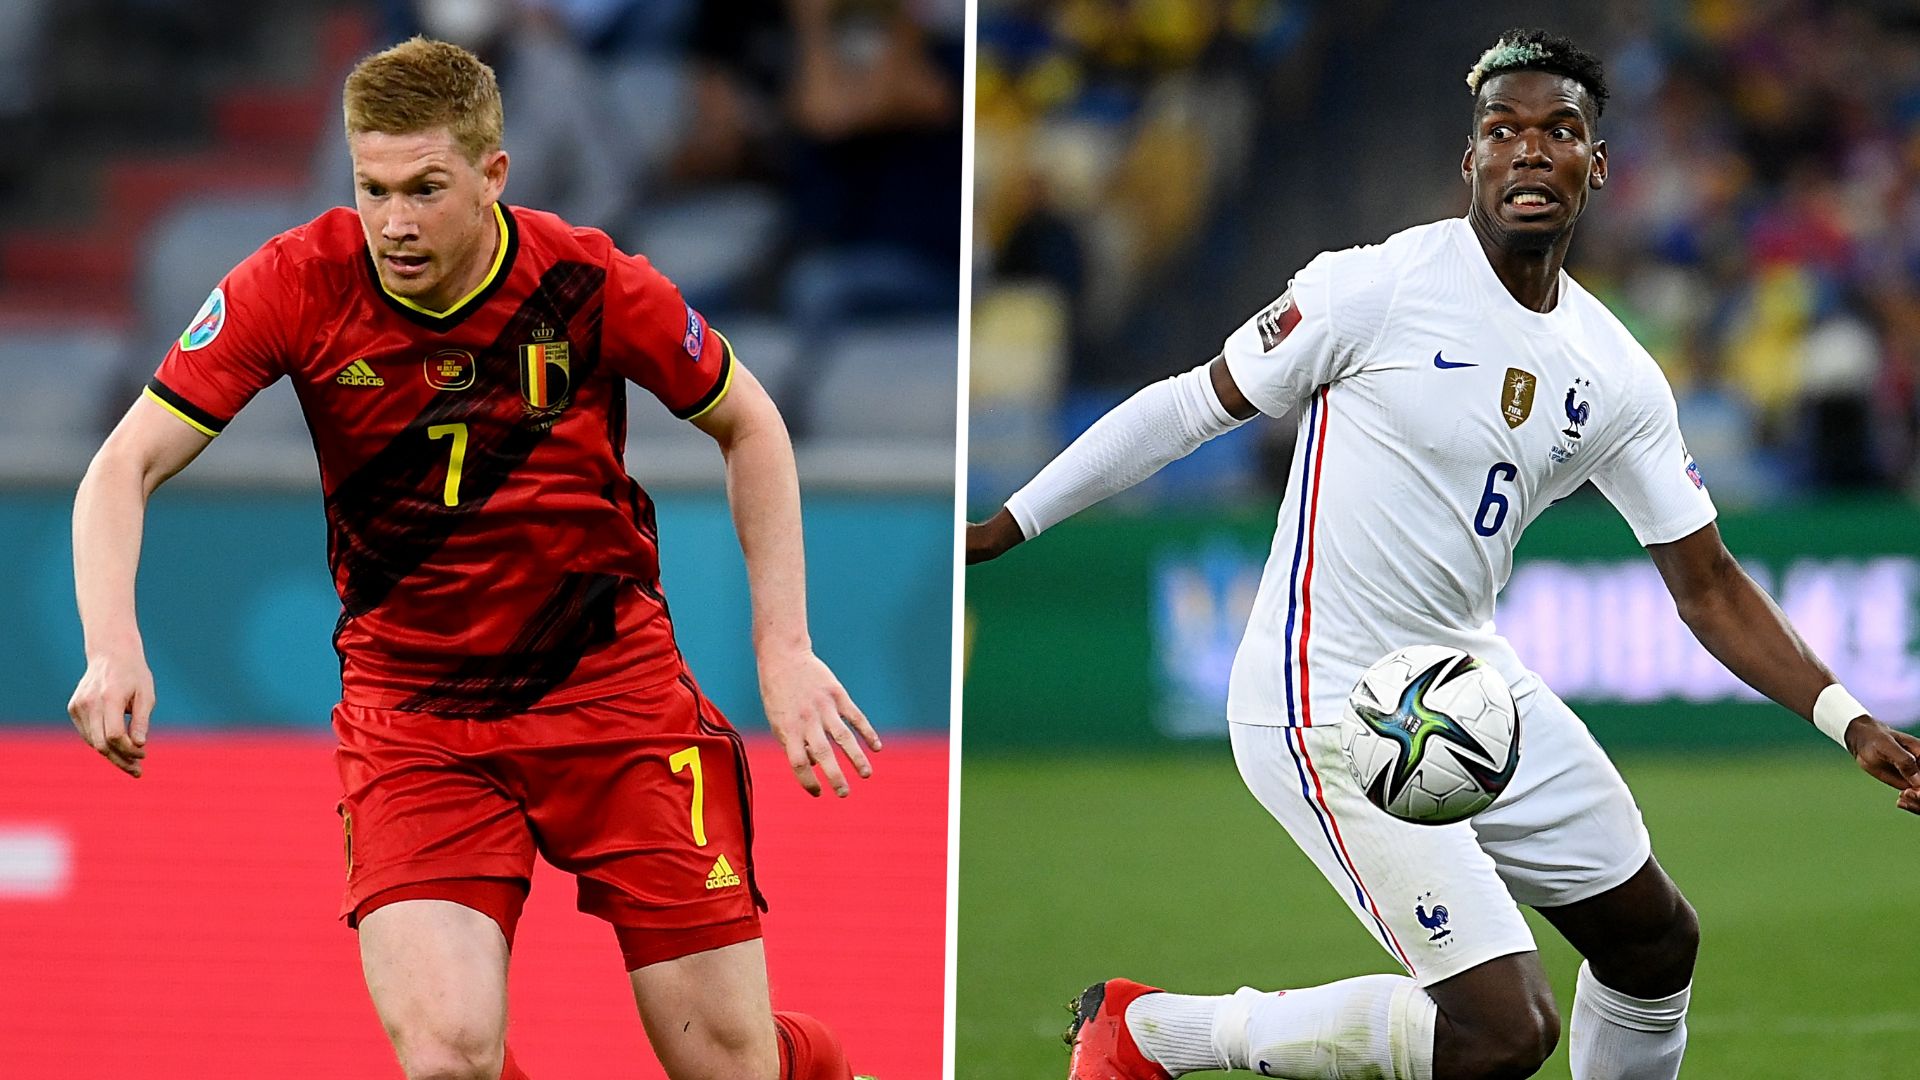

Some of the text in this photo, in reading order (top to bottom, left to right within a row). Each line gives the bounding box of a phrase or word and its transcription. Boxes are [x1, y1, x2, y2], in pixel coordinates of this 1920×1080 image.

[336, 375, 385, 387] adidas
[427, 422, 468, 507] 7
[1473, 462, 1518, 537] 6
[668, 745, 708, 847] 7
[705, 874, 741, 890] adidas
